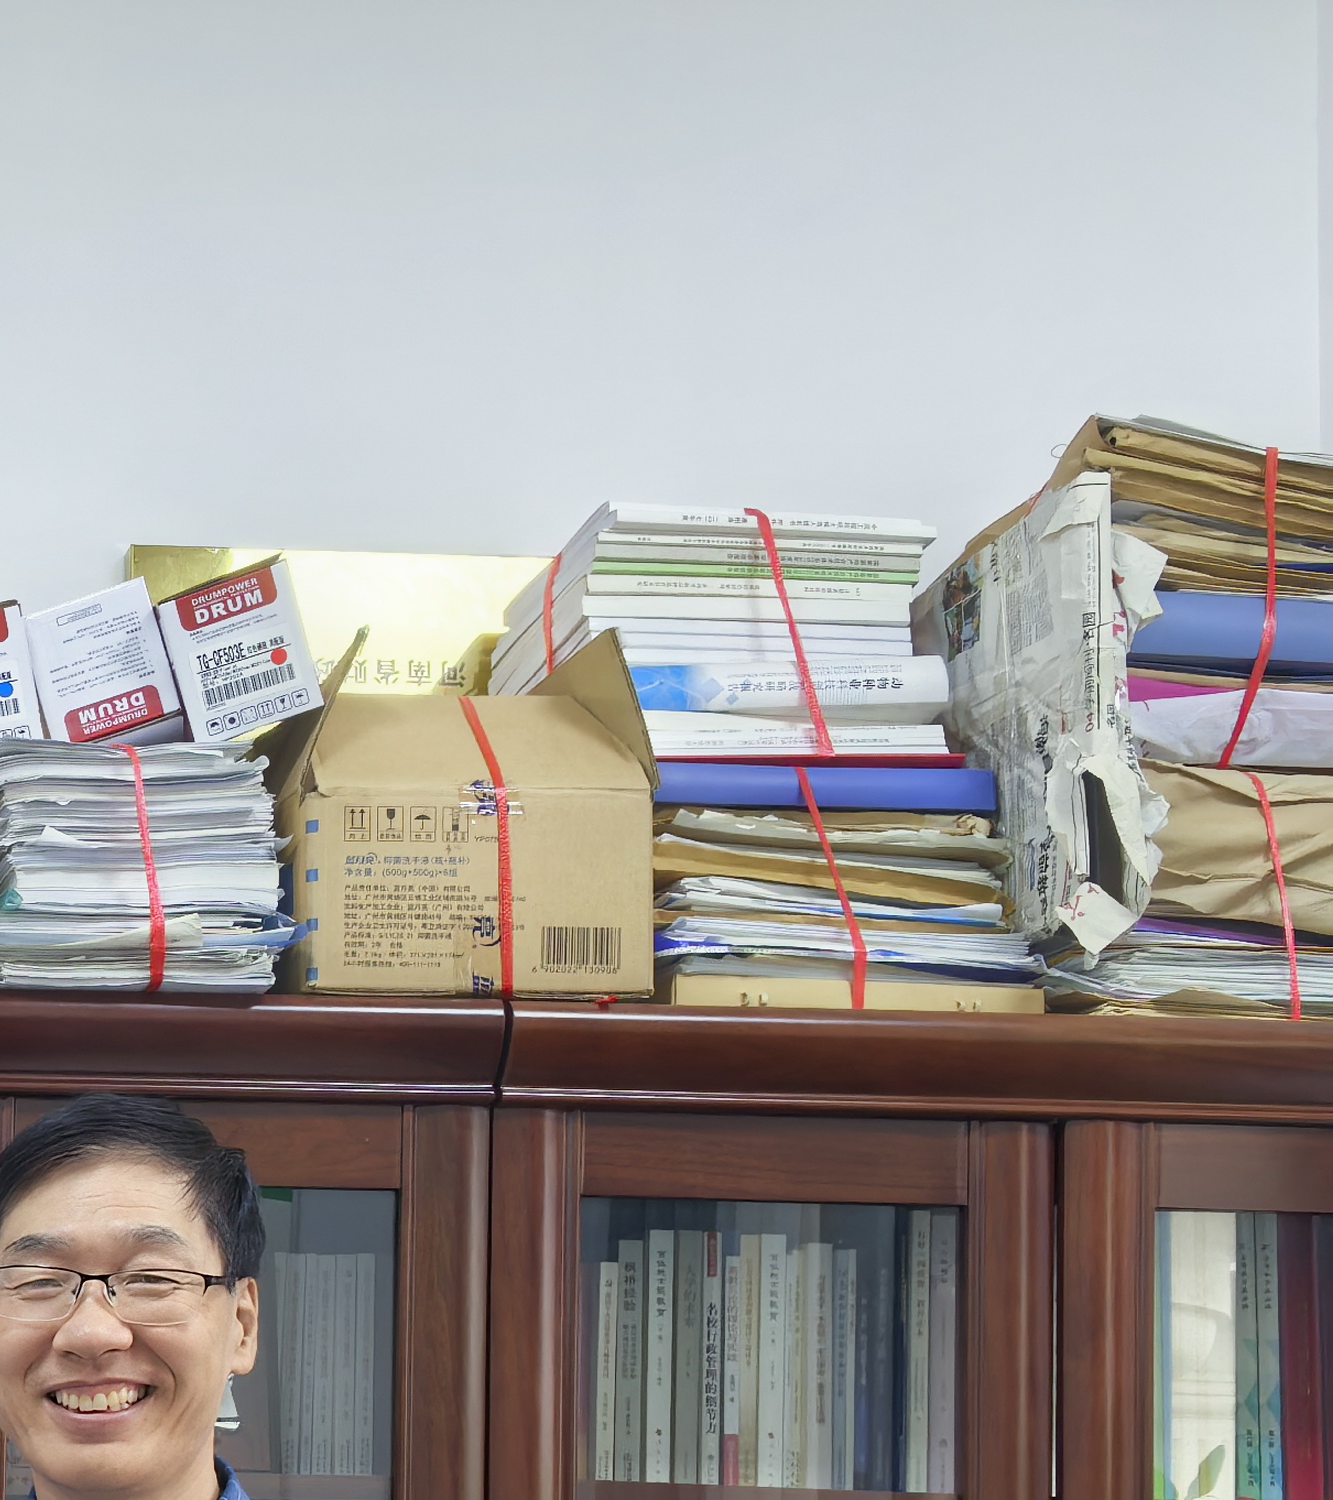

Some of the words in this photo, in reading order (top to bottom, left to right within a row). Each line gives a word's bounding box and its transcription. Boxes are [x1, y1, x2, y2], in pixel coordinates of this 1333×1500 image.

[191, 578, 258, 606] DRUMPOWER
[194, 589, 263, 625] DRUM
[196, 642, 246, 671] TG-CF503E
[78, 691, 146, 724] DRUM
[82, 708, 148, 735] DRUMPOWER
